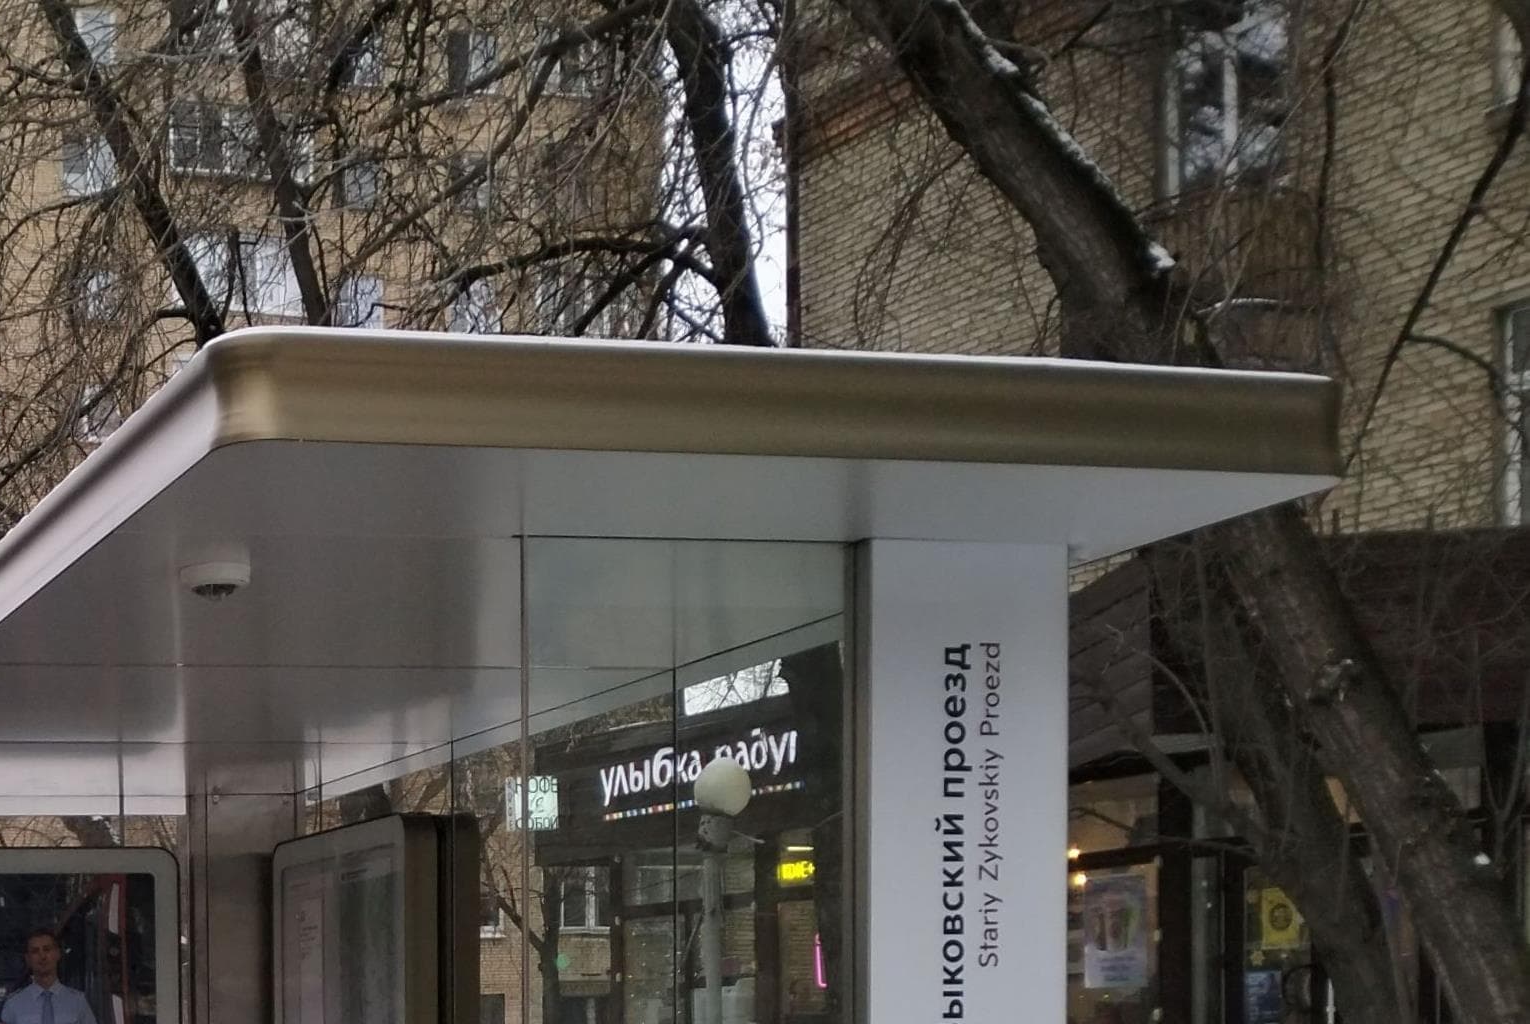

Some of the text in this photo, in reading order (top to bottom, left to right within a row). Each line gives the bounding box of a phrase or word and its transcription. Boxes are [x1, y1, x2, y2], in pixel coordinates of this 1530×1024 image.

[600, 747, 702, 807] улыбка
[942, 643, 972, 798] проезд
[977, 642, 1005, 968] Stariy Zykovskiy Proezd
